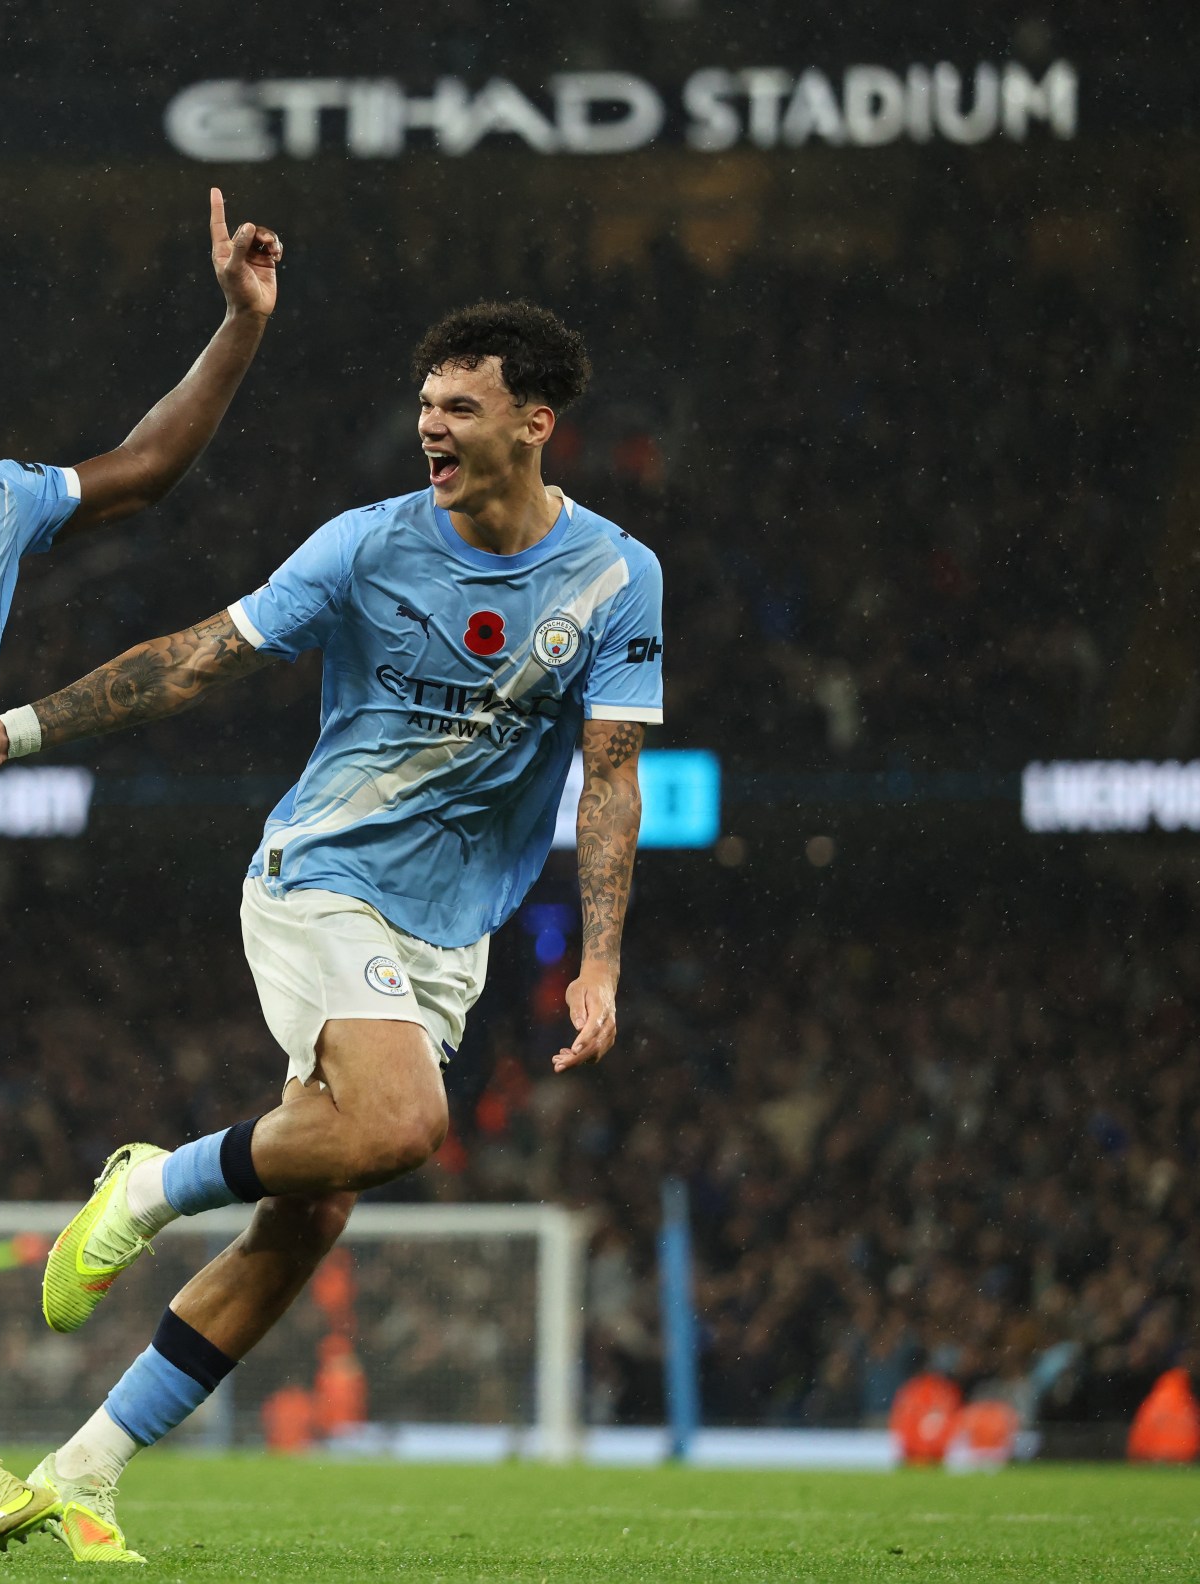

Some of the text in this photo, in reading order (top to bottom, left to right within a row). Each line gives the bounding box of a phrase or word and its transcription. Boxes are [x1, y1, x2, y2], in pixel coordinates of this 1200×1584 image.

[163, 56, 1079, 163] ETIHAD STADIUM
[538, 621, 577, 639] MANCHESTER
[407, 711, 522, 744] AIRWAYS
